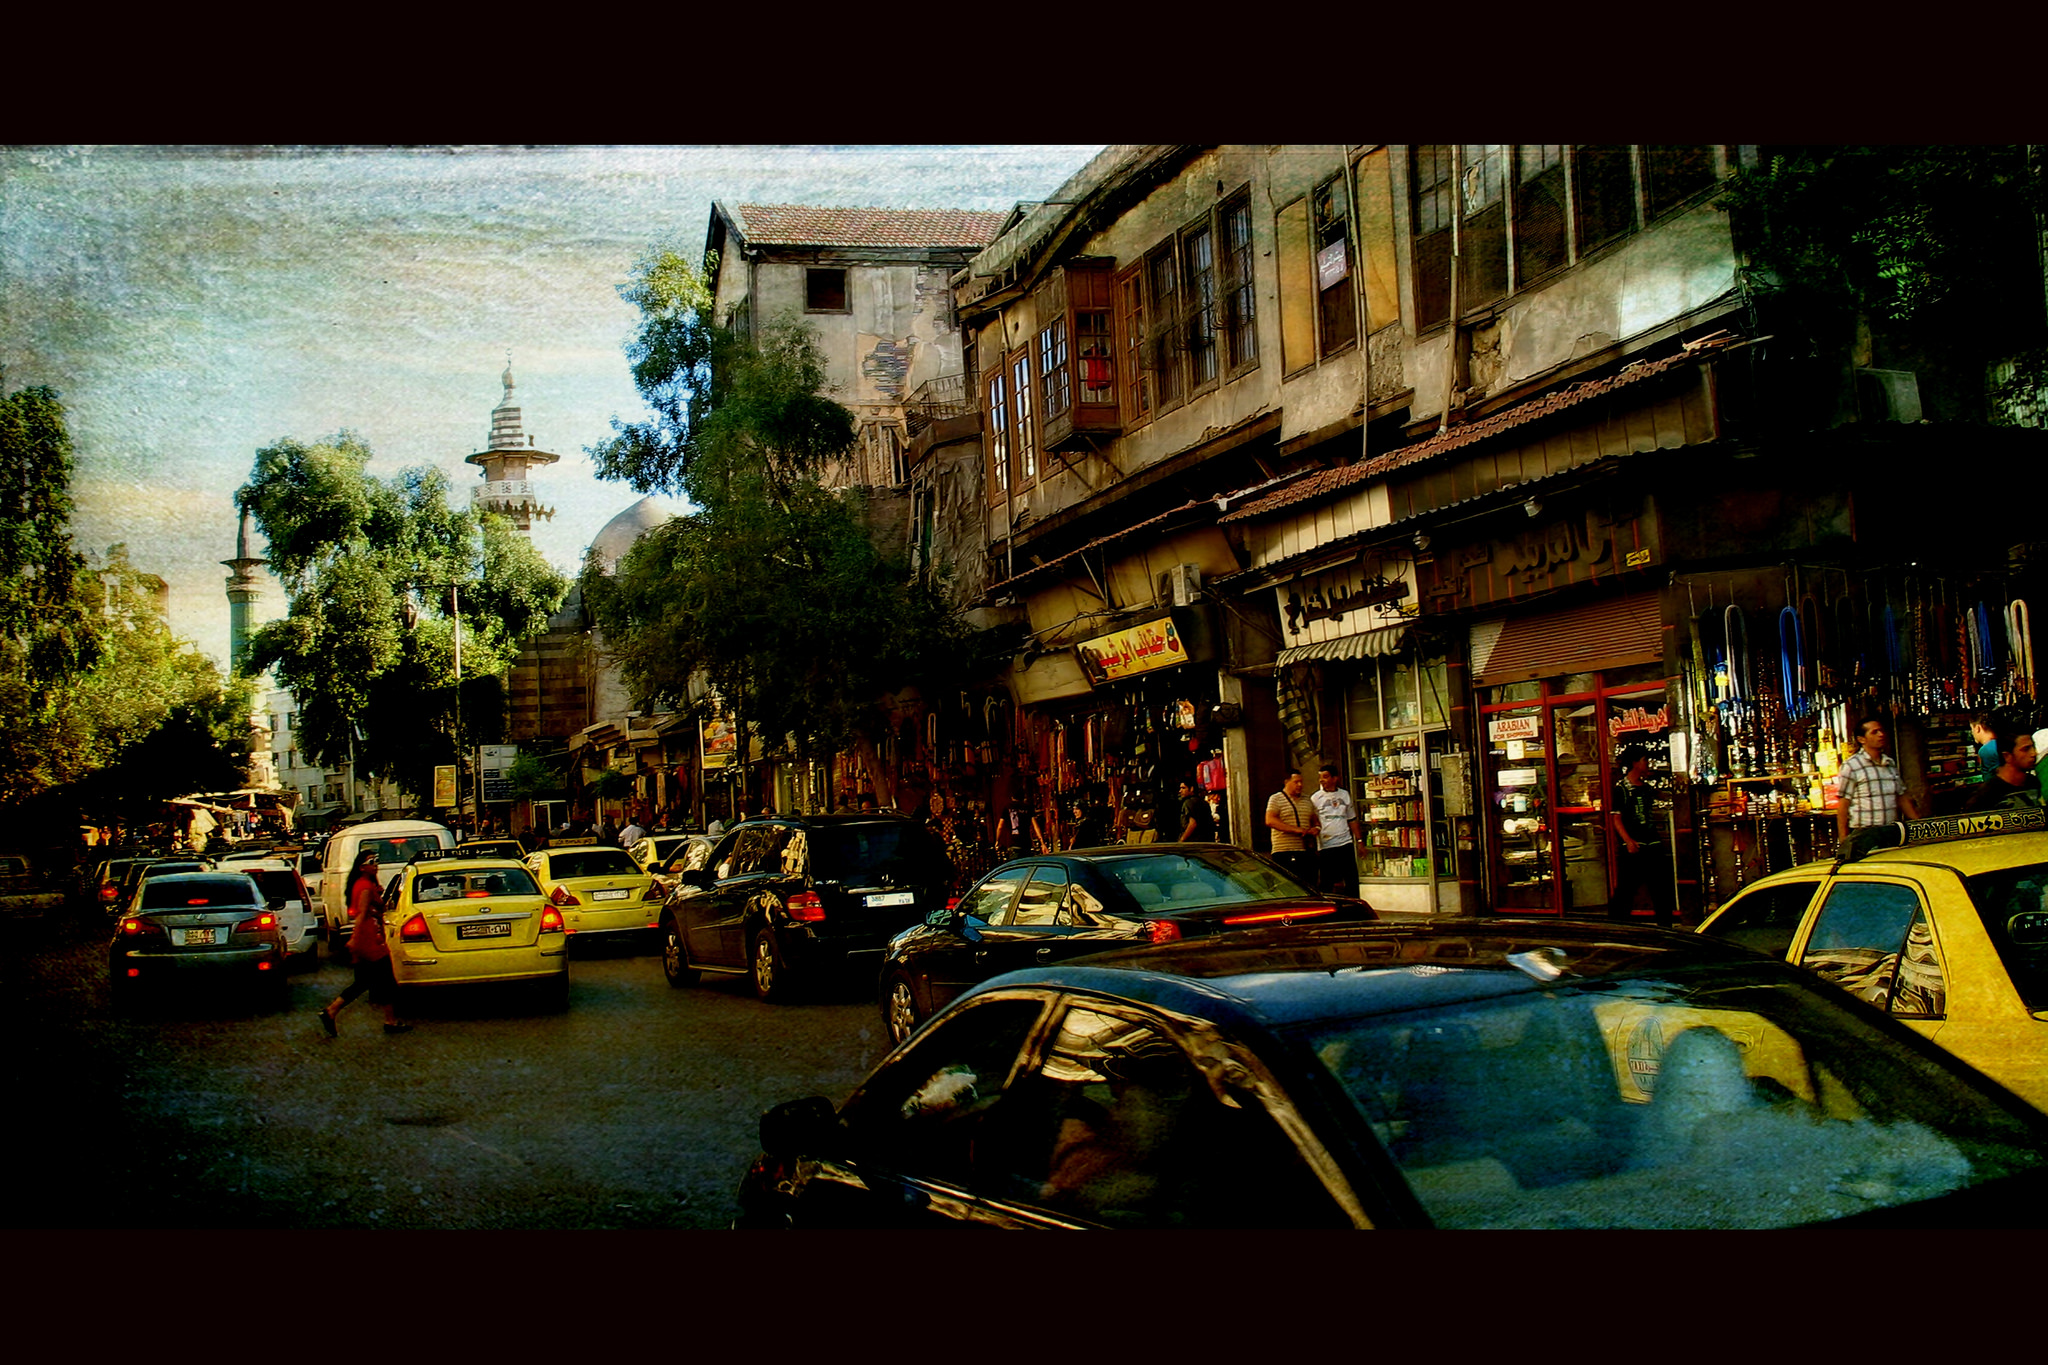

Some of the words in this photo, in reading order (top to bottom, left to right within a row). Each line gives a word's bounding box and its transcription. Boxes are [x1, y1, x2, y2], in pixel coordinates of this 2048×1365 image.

[1496, 718, 1531, 732] ARABIAN
[1638, 703, 1669, 733] لعربية
[1506, 730, 1534, 739] SHIPPING
[1911, 820, 1950, 842] TAXI
[422, 850, 445, 858] TAXI
